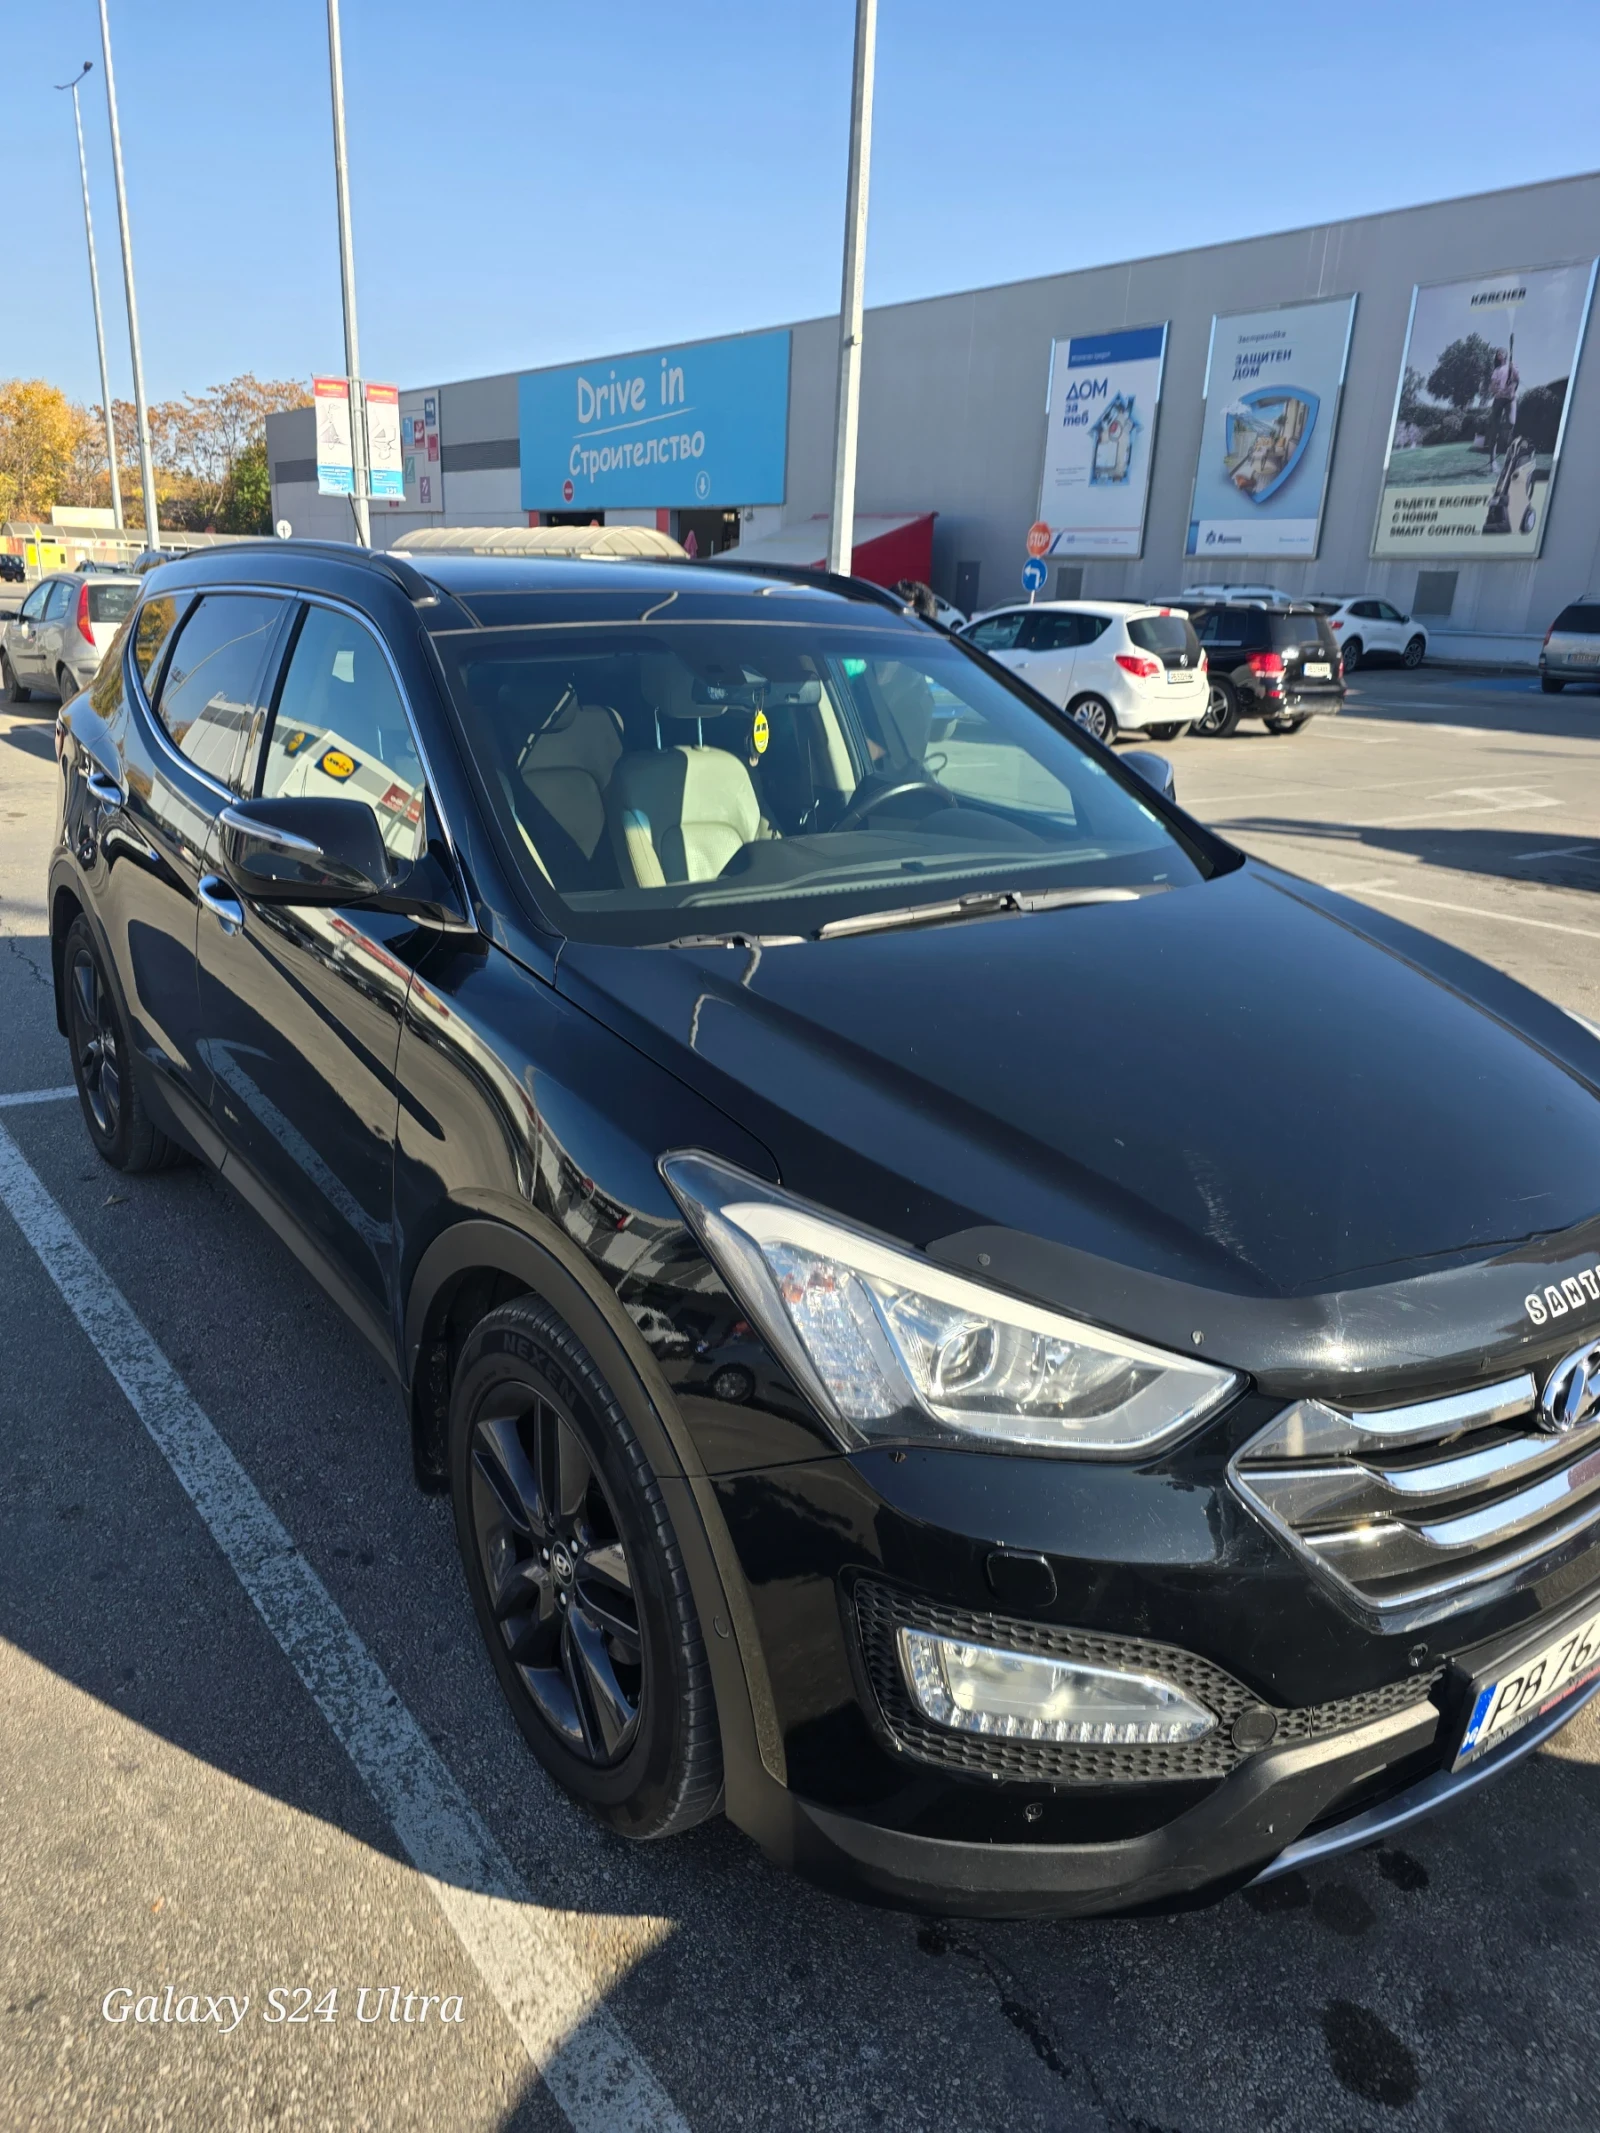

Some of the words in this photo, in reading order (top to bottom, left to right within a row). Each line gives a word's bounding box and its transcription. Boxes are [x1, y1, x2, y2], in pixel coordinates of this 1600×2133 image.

[1235, 348, 1292, 367] ЗАЩИТЕН
[1232, 365, 1261, 381] ДОМ
[577, 370, 646, 424] Drive
[661, 357, 685, 406] in
[569, 430, 706, 484] Строителство
[1029, 532, 1050, 547] STOP
[1389, 526, 1425, 538] SMART
[503, 1332, 577, 1408] NEXEN
